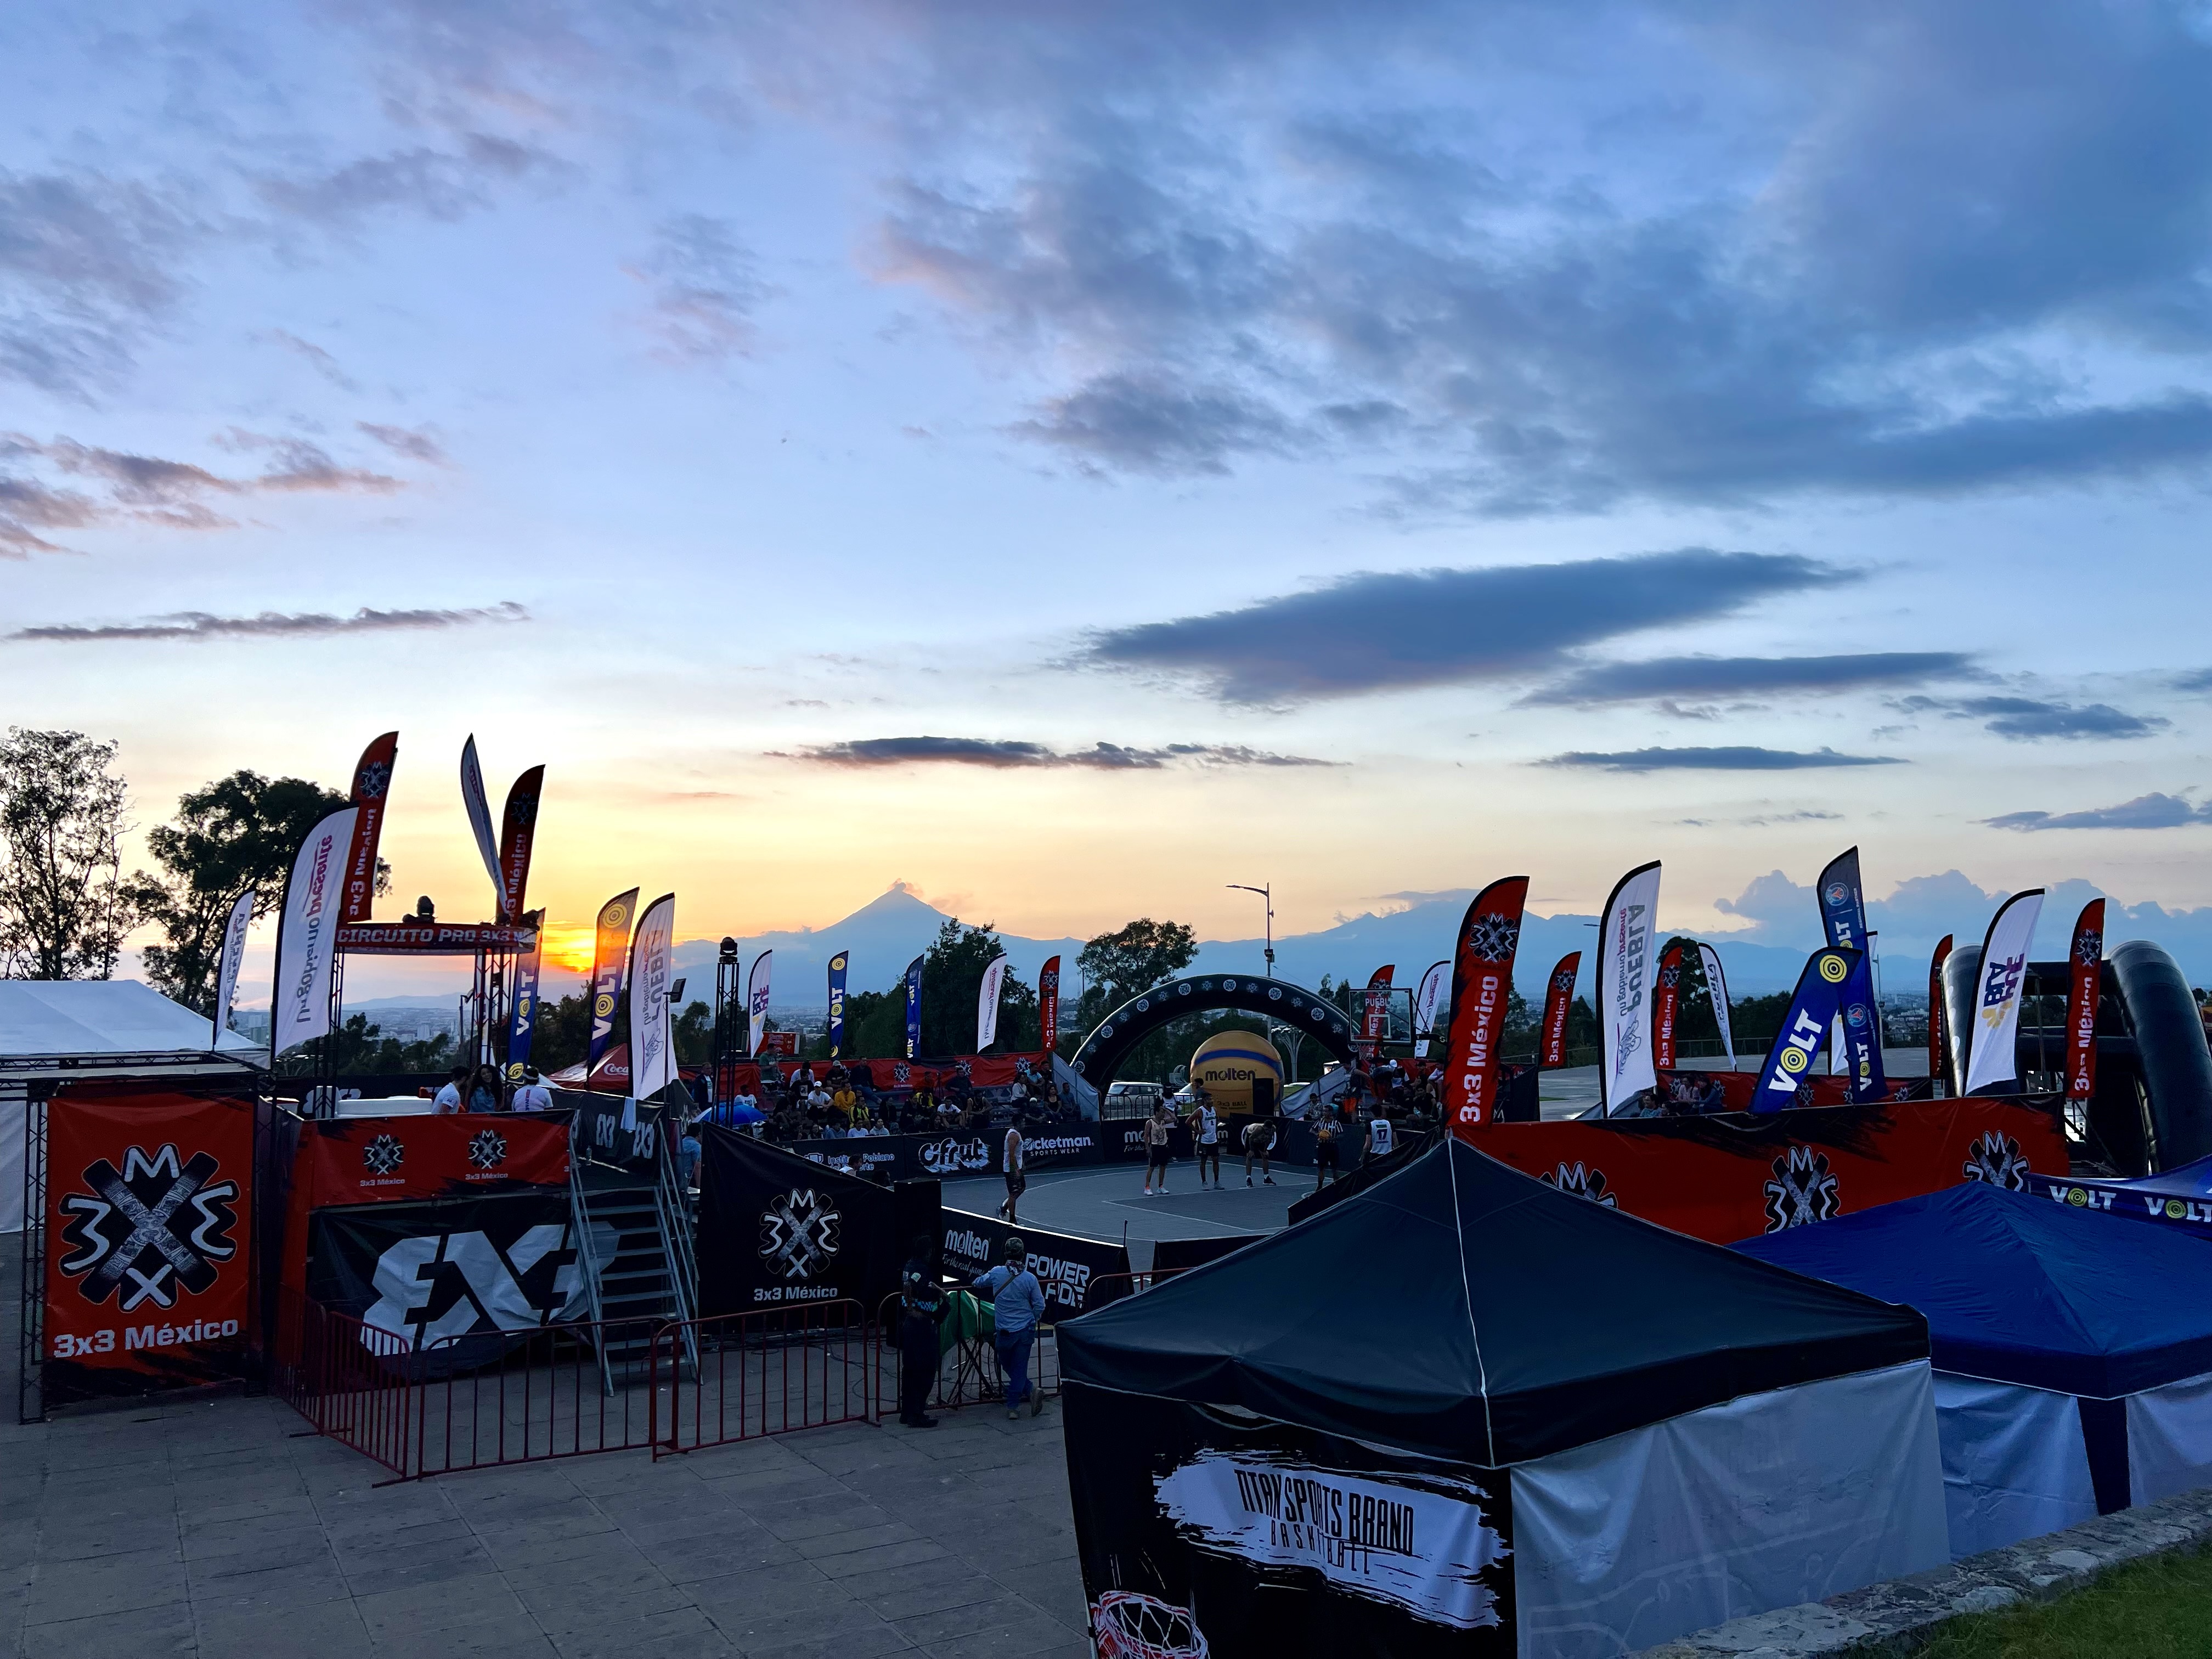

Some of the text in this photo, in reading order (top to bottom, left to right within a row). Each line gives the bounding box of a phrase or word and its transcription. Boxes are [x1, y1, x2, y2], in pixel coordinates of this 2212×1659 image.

[337, 928, 433, 943] CIRCUITO
[438, 929, 476, 943] PRO
[480, 930, 510, 941] 3X3
[1835, 921, 1853, 948] OLT
[516, 970, 536, 1036] VOLT
[591, 964, 617, 1041] VOLT
[831, 987, 843, 1029] VOLT
[1549, 997, 1566, 1062] 3x3 México
[1460, 976, 1498, 1122] 3x3 México
[1768, 1008, 1822, 1092] VOLT
[1205, 1068, 1255, 1081] molten
[1857, 1042, 1872, 1091] VOLT
[1023, 1136, 1091, 1152] ocketman
[1376, 1128, 1388, 1141] 17
[862, 1153, 895, 1163] Poblano
[2049, 1185, 2117, 1210] VOLT
[2143, 1196, 2212, 1223] VOLT
[944, 1229, 990, 1261] molten
[1024, 1252, 1090, 1288] POWER
[753, 1285, 838, 1301] 3x3 México
[54, 1318, 238, 1358] 3x3 México
[1233, 1469, 1414, 1556] TITAN SPORTS BRAND
